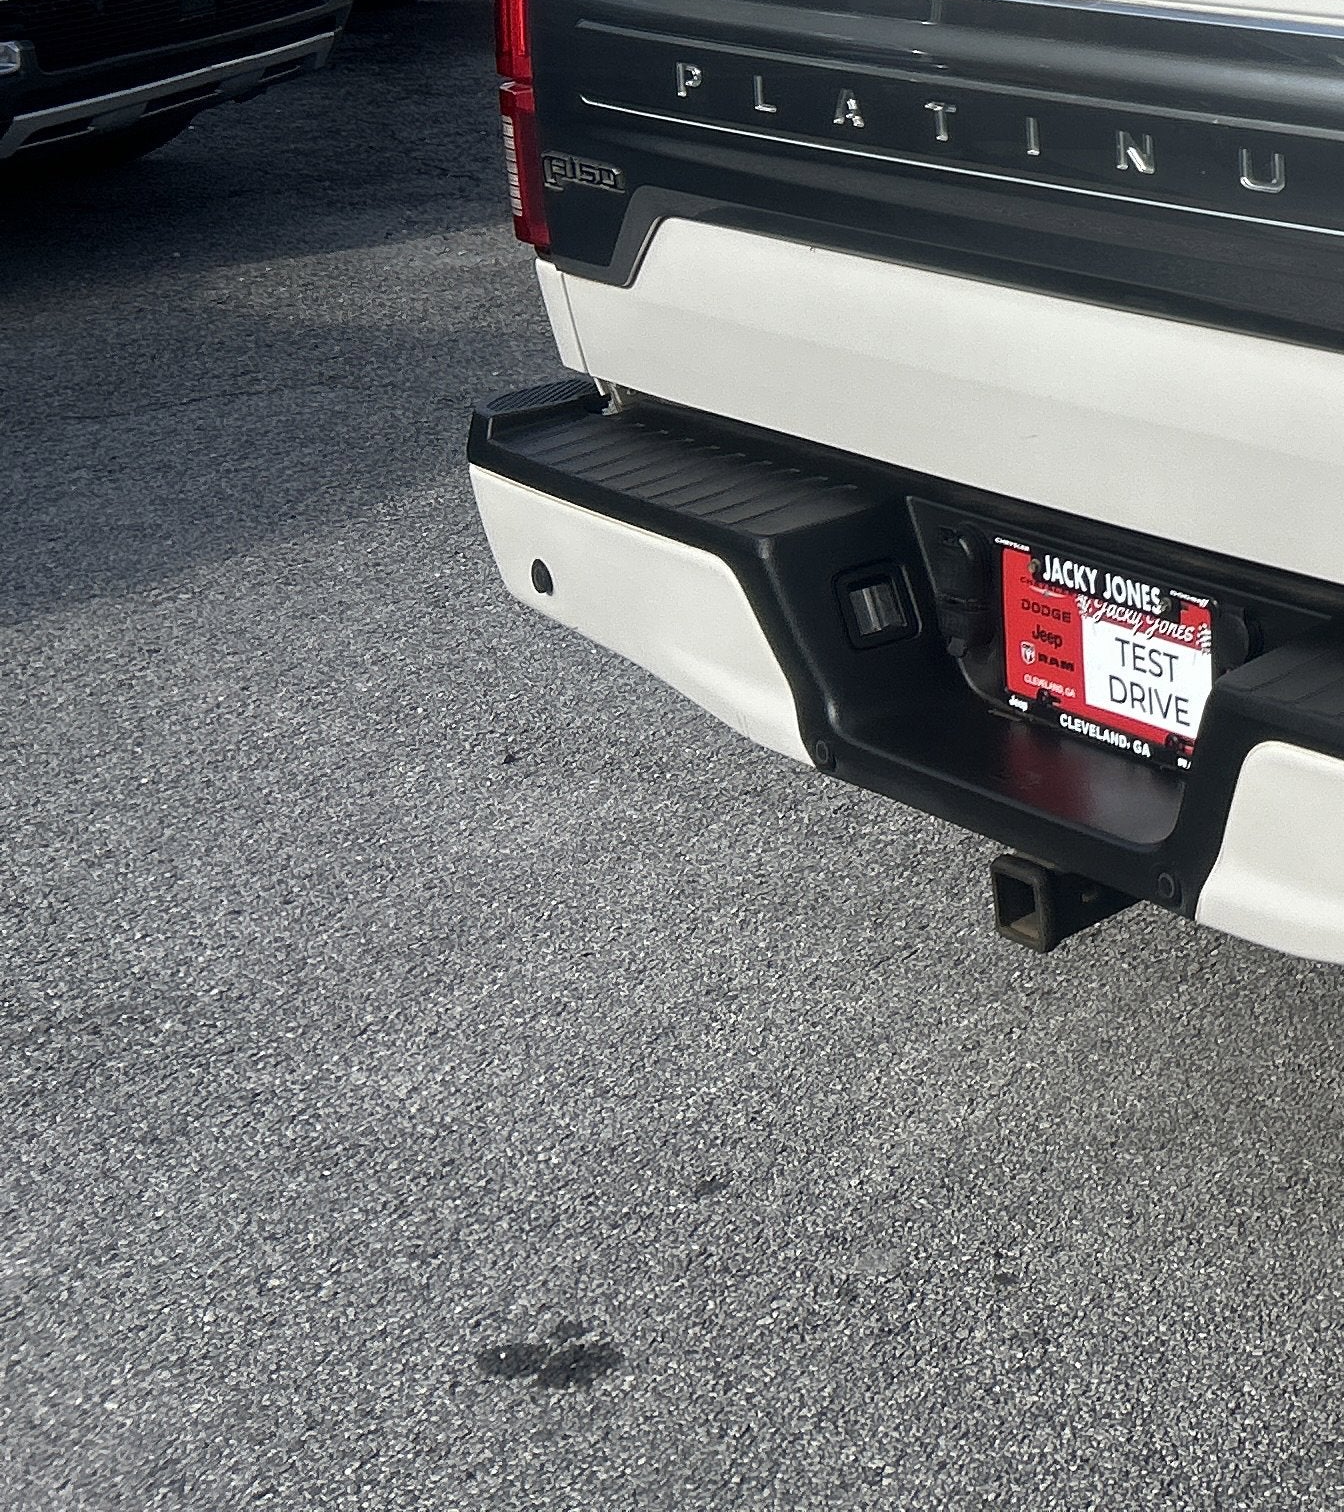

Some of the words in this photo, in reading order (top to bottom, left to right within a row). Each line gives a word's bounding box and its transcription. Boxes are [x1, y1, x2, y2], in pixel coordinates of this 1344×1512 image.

[1042, 554, 1098, 594] JACKY
[1103, 573, 1162, 615] JONES
[1020, 598, 1072, 623] DODGE
[1032, 624, 1063, 648] Jeep
[1038, 652, 1075, 672] RAM
[1115, 637, 1179, 682] TEST
[1109, 674, 1191, 727] DRIVE
[1059, 713, 1131, 750] CLEVELAND,
[1132, 739, 1151, 757] GA
